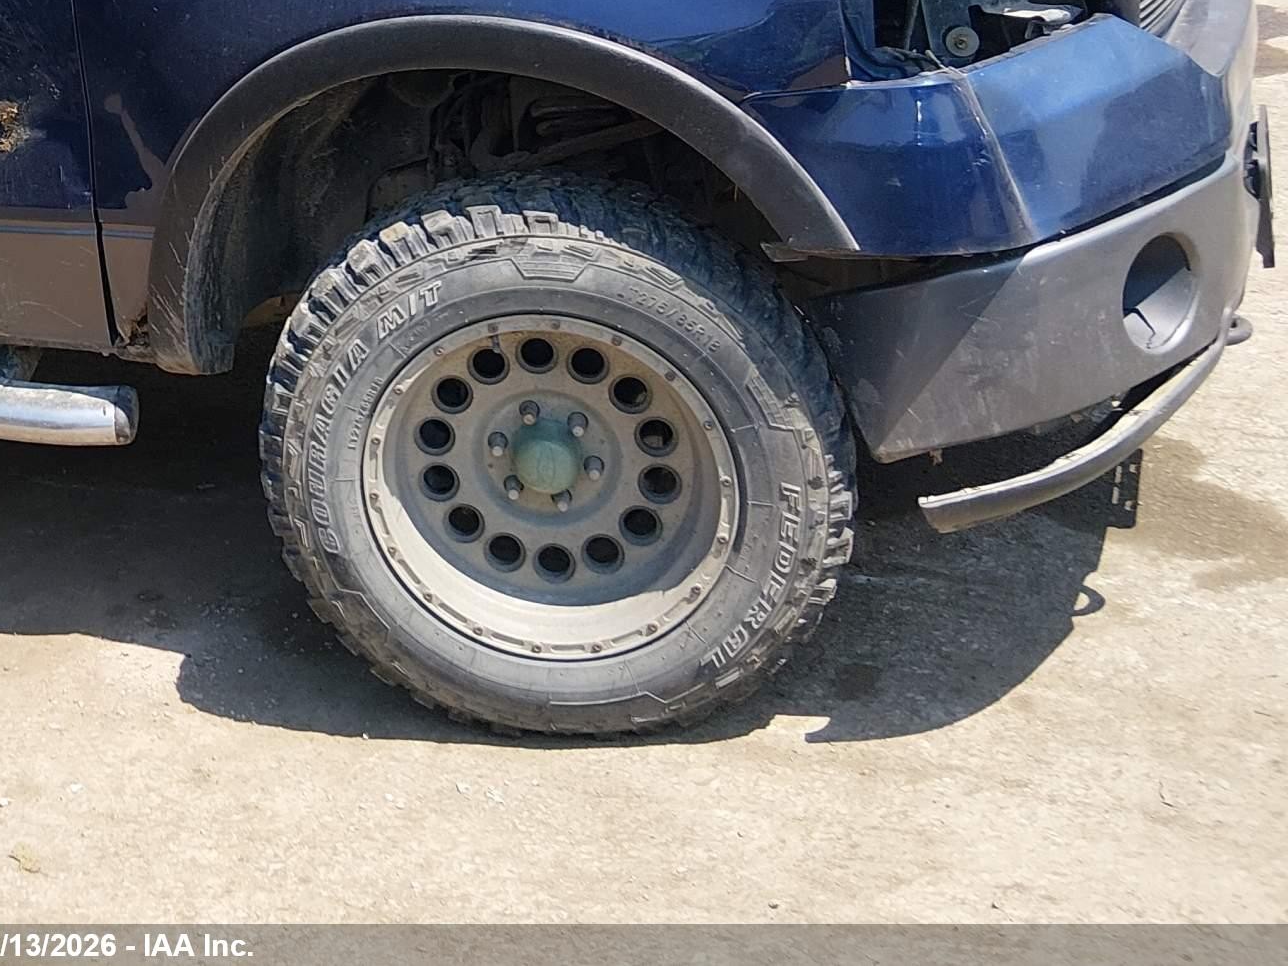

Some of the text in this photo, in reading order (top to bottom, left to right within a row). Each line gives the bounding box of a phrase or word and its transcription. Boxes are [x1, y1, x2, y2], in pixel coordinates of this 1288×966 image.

[308, 337, 371, 554] COURAGIA
[375, 280, 442, 340] M/T
[699, 481, 803, 669] FEDERAL
